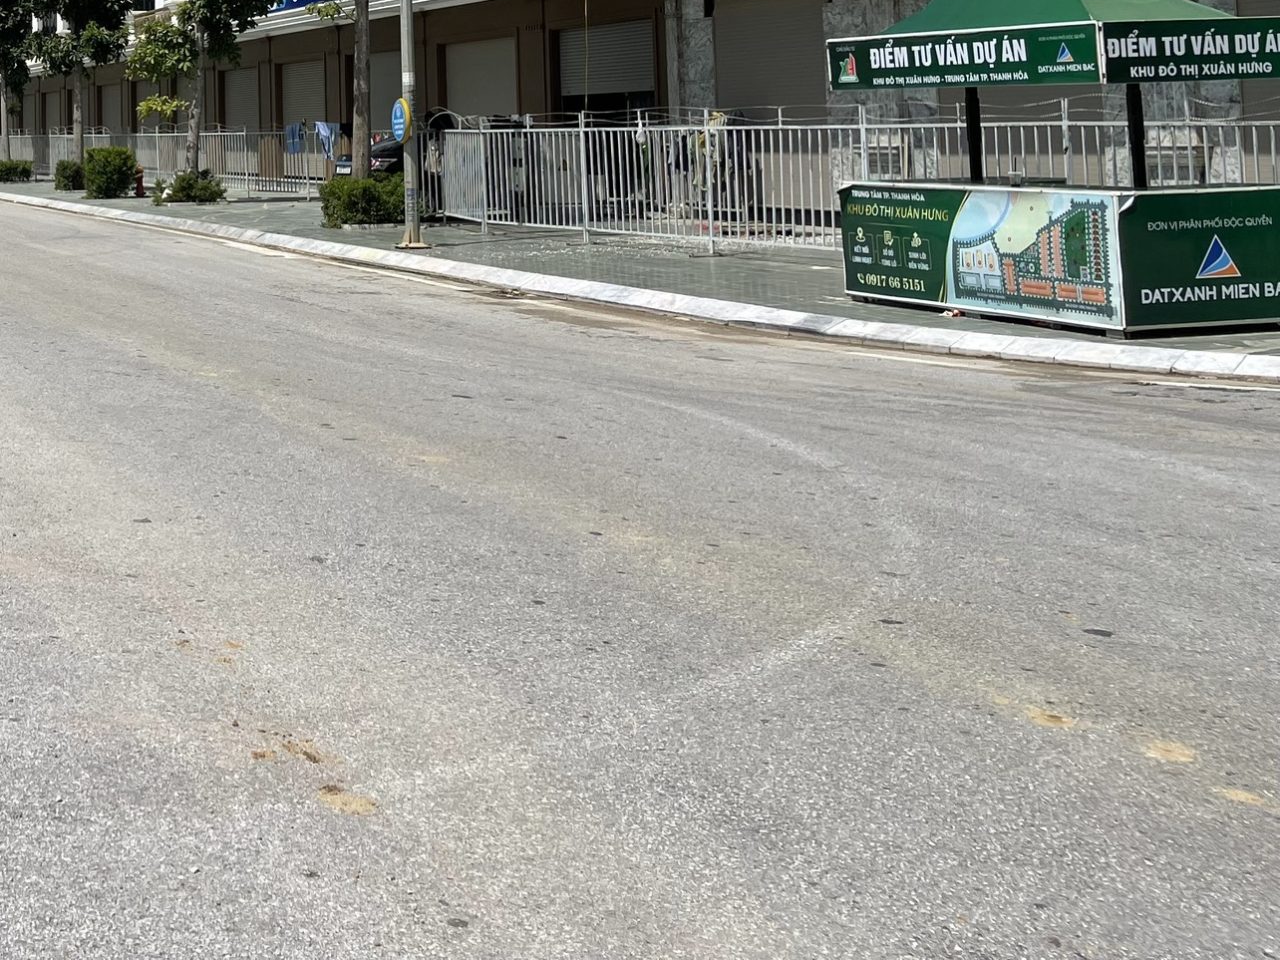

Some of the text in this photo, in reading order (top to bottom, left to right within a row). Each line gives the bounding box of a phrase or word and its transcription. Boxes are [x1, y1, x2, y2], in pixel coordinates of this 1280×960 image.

[869, 35, 1027, 69] ĐIỂM TƯ VẤN DỰ ÁN
[1107, 29, 1157, 58] ĐIỂM
[1161, 34, 1187, 56] TƯ
[1190, 28, 1229, 56] VẤN
[1234, 32, 1261, 58] DỰ
[990, 72, 1012, 81] THANH
[1130, 61, 1273, 79] KHU ĐÔ THỊ XUÂN HƯNG
[847, 203, 949, 221] KHU ĐÔ THỊ XUÂN HƯNG
[1147, 221, 1168, 231] ĐƠN
[1179, 218, 1202, 230] PHÂN
[866, 273, 925, 292] 0917 66 5151
[1141, 285, 1217, 304] DATXANH
[1221, 283, 1260, 300] MIEN
